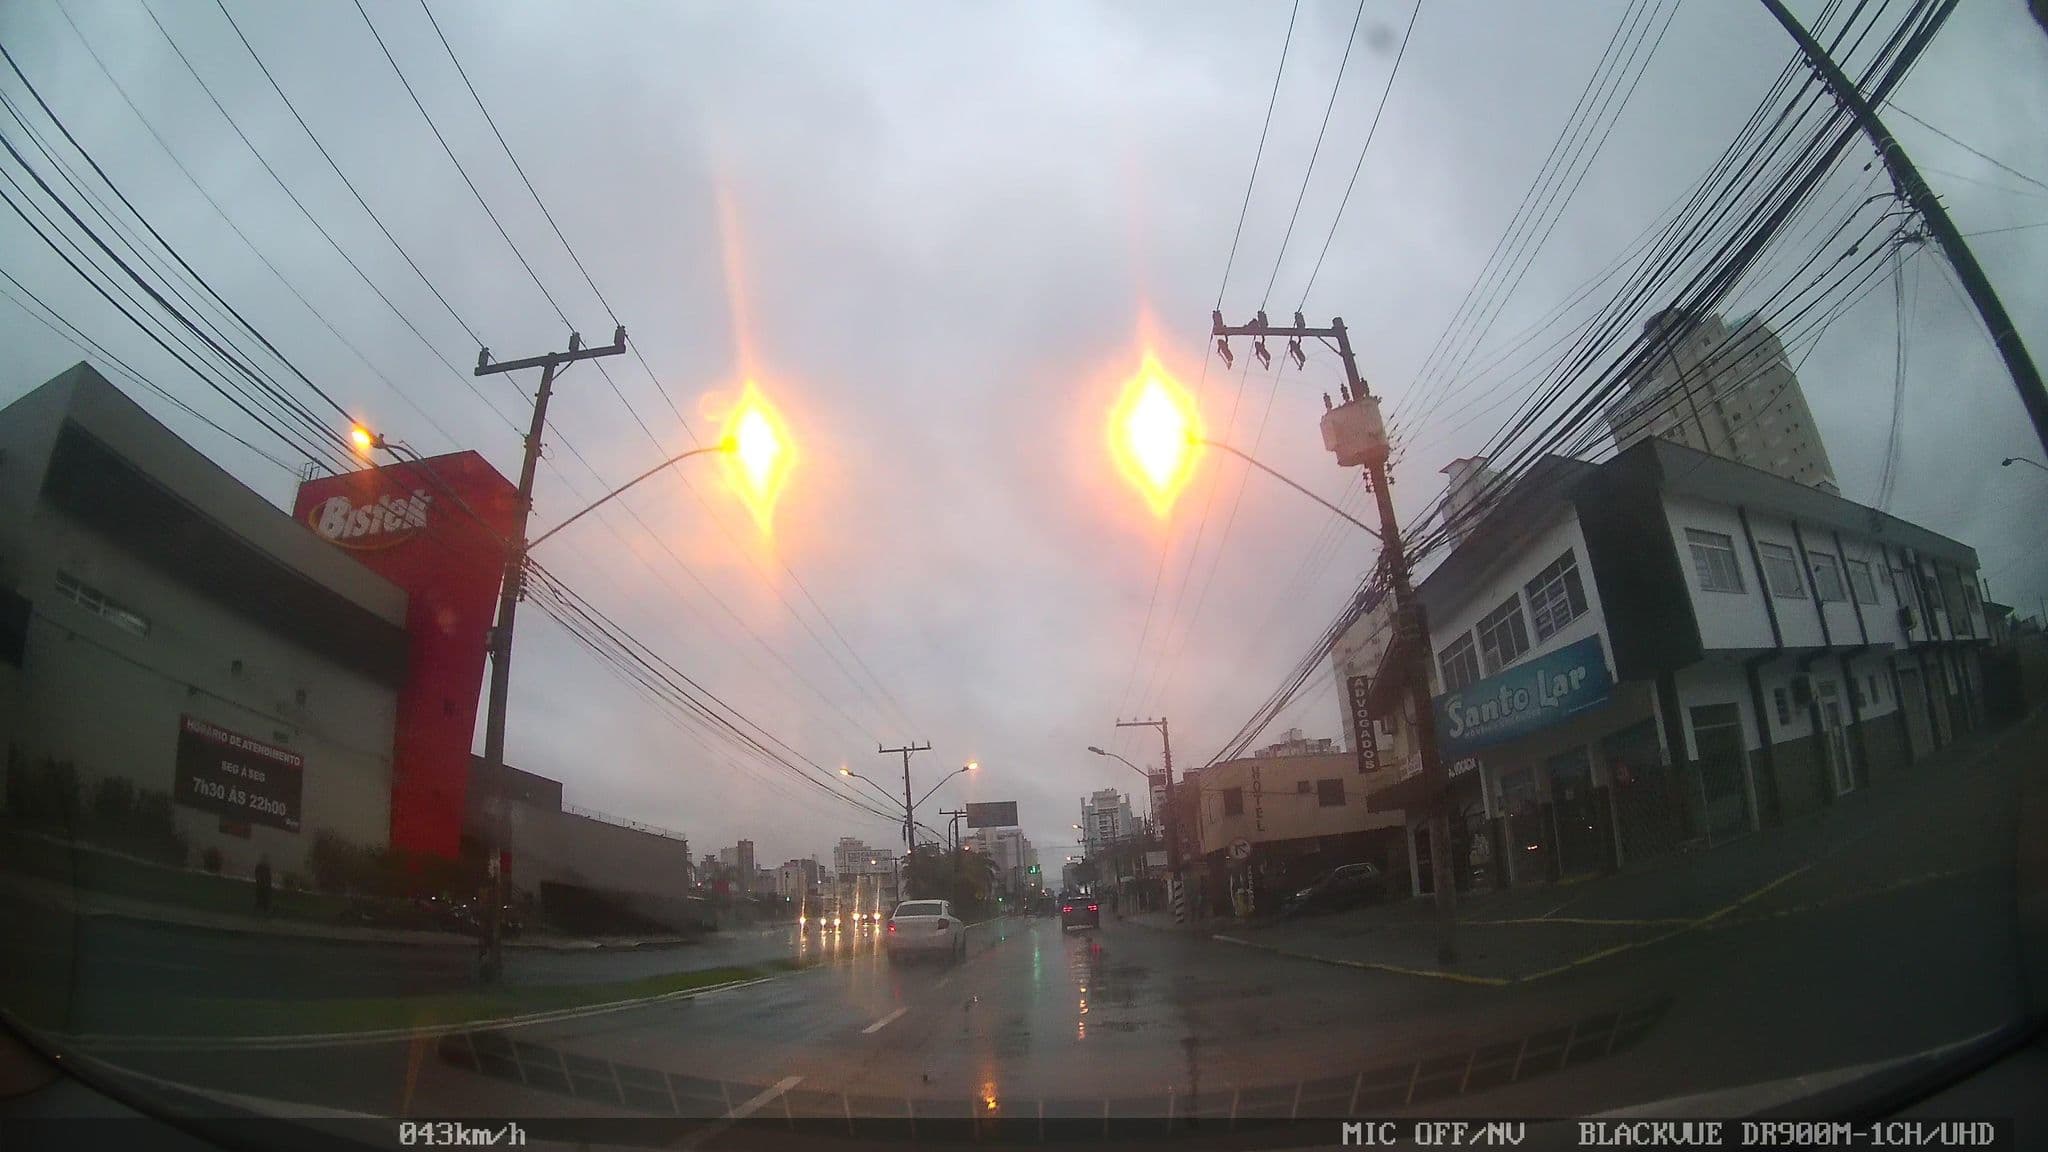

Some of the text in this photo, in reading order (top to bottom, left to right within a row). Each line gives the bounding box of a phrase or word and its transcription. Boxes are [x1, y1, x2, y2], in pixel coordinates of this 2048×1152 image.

[320, 489, 433, 539] Bistek
[1354, 678, 1376, 770] ADVOGADOS
[1447, 685, 1529, 738] Santo
[1536, 668, 1586, 708] Lar
[229, 734, 242, 748] DE
[242, 739, 301, 767] ATENDIMENTO
[192, 776, 226, 800] 7h30
[249, 794, 287, 818] 22h00
